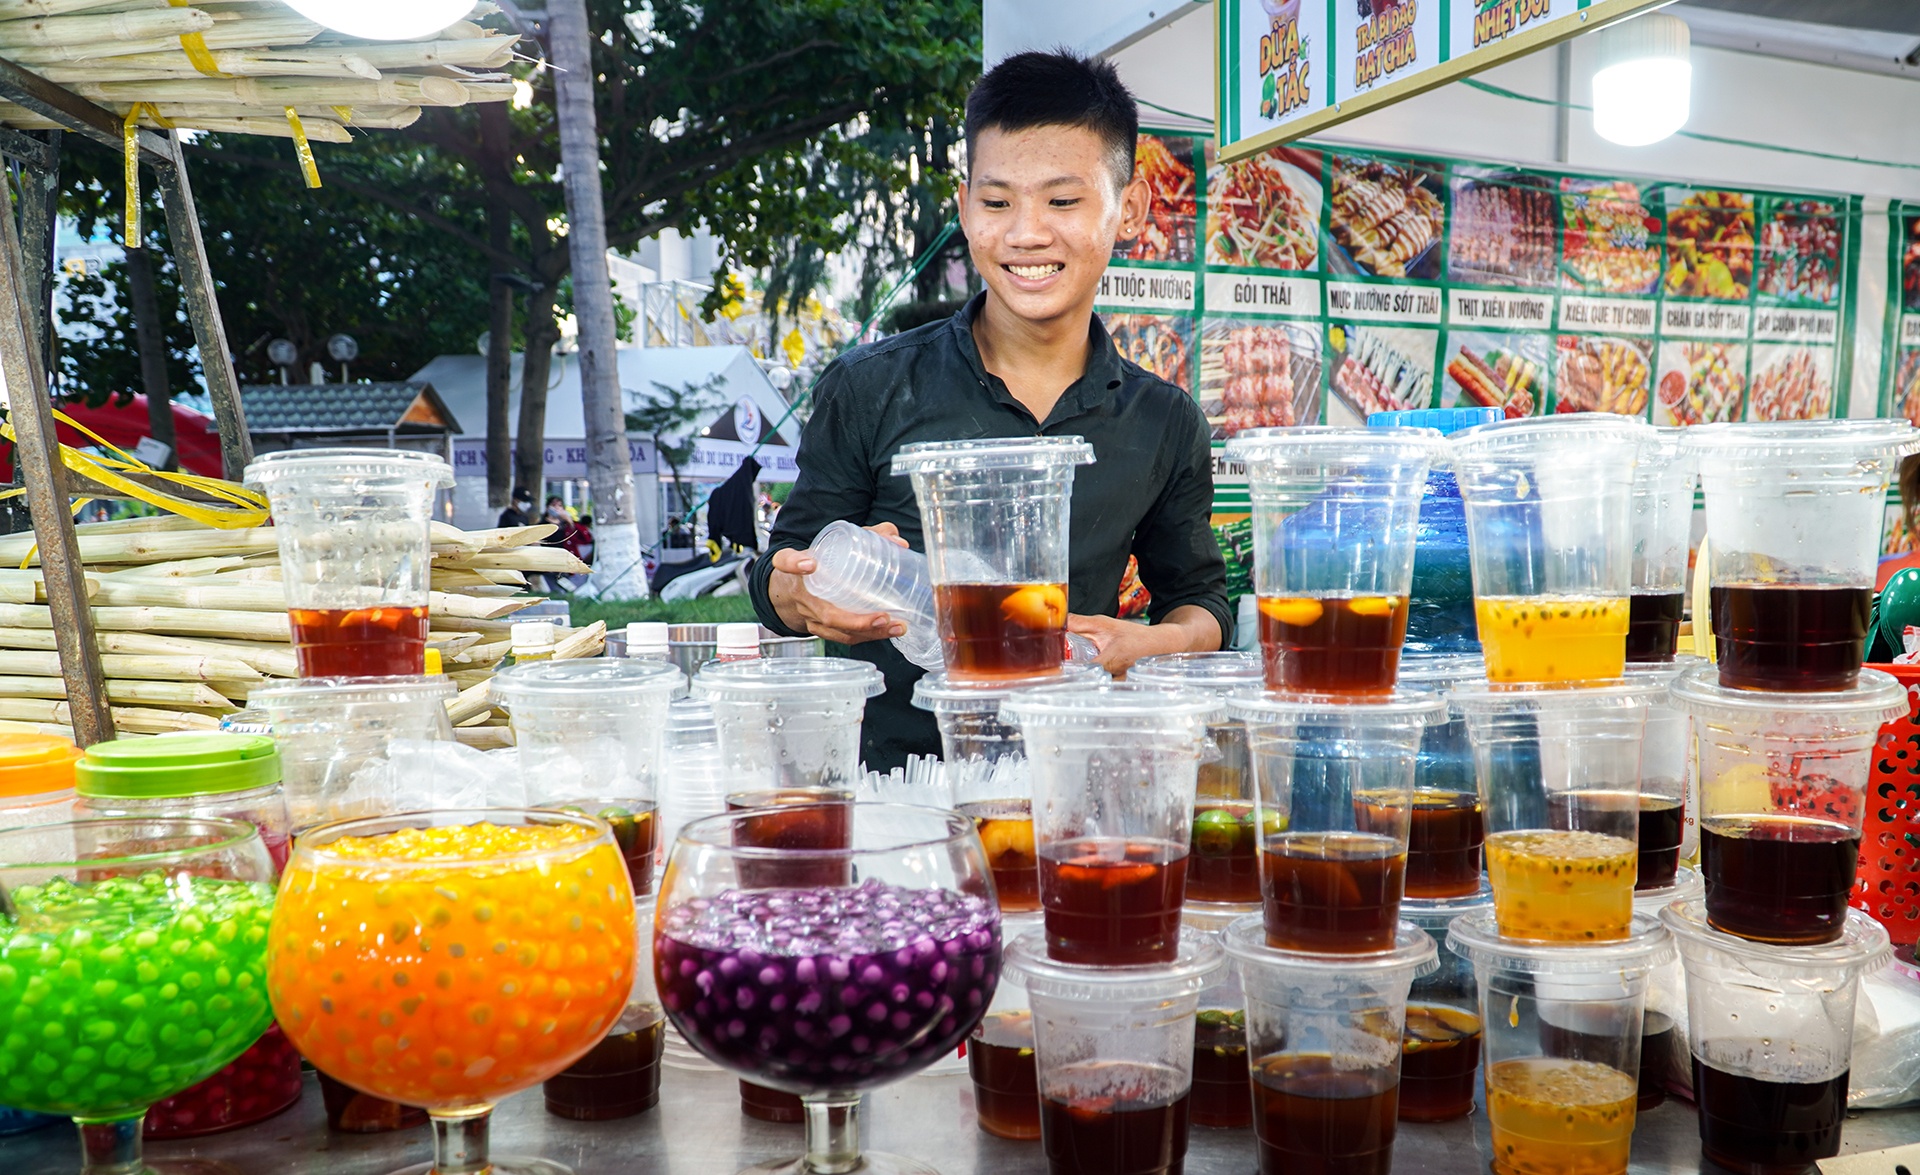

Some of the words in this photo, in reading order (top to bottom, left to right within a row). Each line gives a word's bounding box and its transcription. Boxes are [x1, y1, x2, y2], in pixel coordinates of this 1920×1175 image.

[1276, 53, 1310, 116] TẮC
[1114, 272, 1145, 301] TUỘC
[1150, 274, 1191, 300] NƯỚNG
[1234, 277, 1257, 303] GỎI
[1262, 281, 1291, 305] THÁI
[1330, 289, 1351, 313] MỰC
[1458, 297, 1478, 320] THỊT
[454, 450, 477, 467] ỊCH
